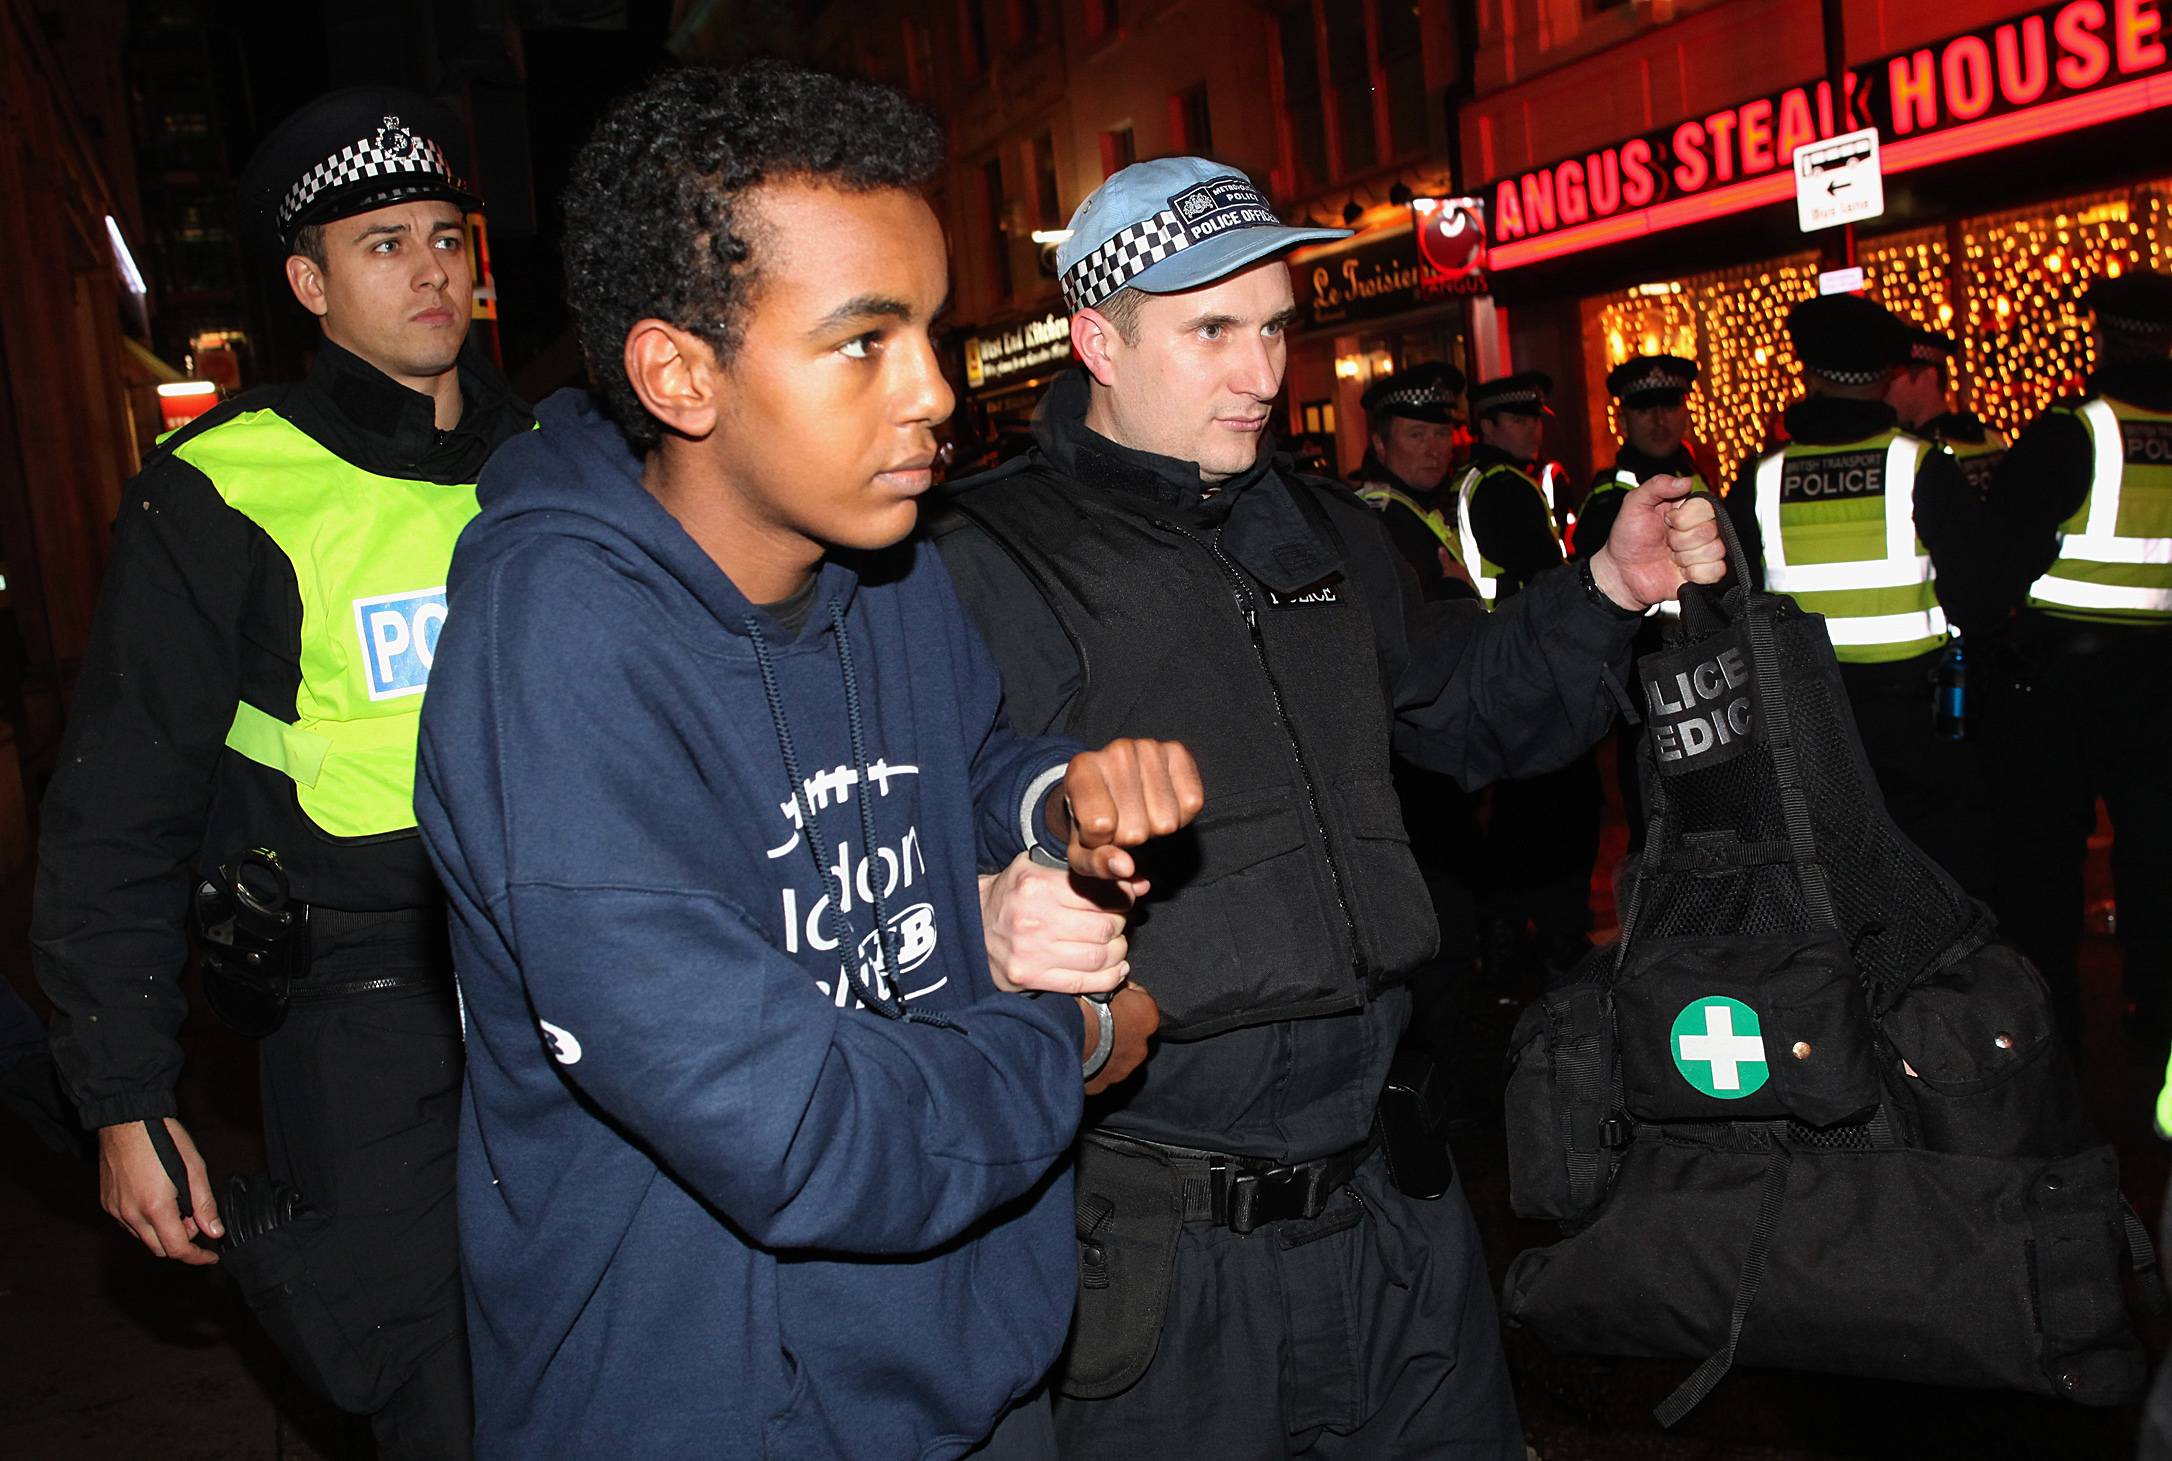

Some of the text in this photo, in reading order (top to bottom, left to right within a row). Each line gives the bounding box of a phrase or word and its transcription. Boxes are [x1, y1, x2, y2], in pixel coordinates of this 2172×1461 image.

[1495, 0, 2166, 242] ANGUS STEAK HOUSE
[1190, 210, 1242, 239] POLICE
[1822, 453, 1882, 469] TRANSPORT
[1784, 468, 1881, 497] POLICE
[1650, 647, 1749, 717] LICE
